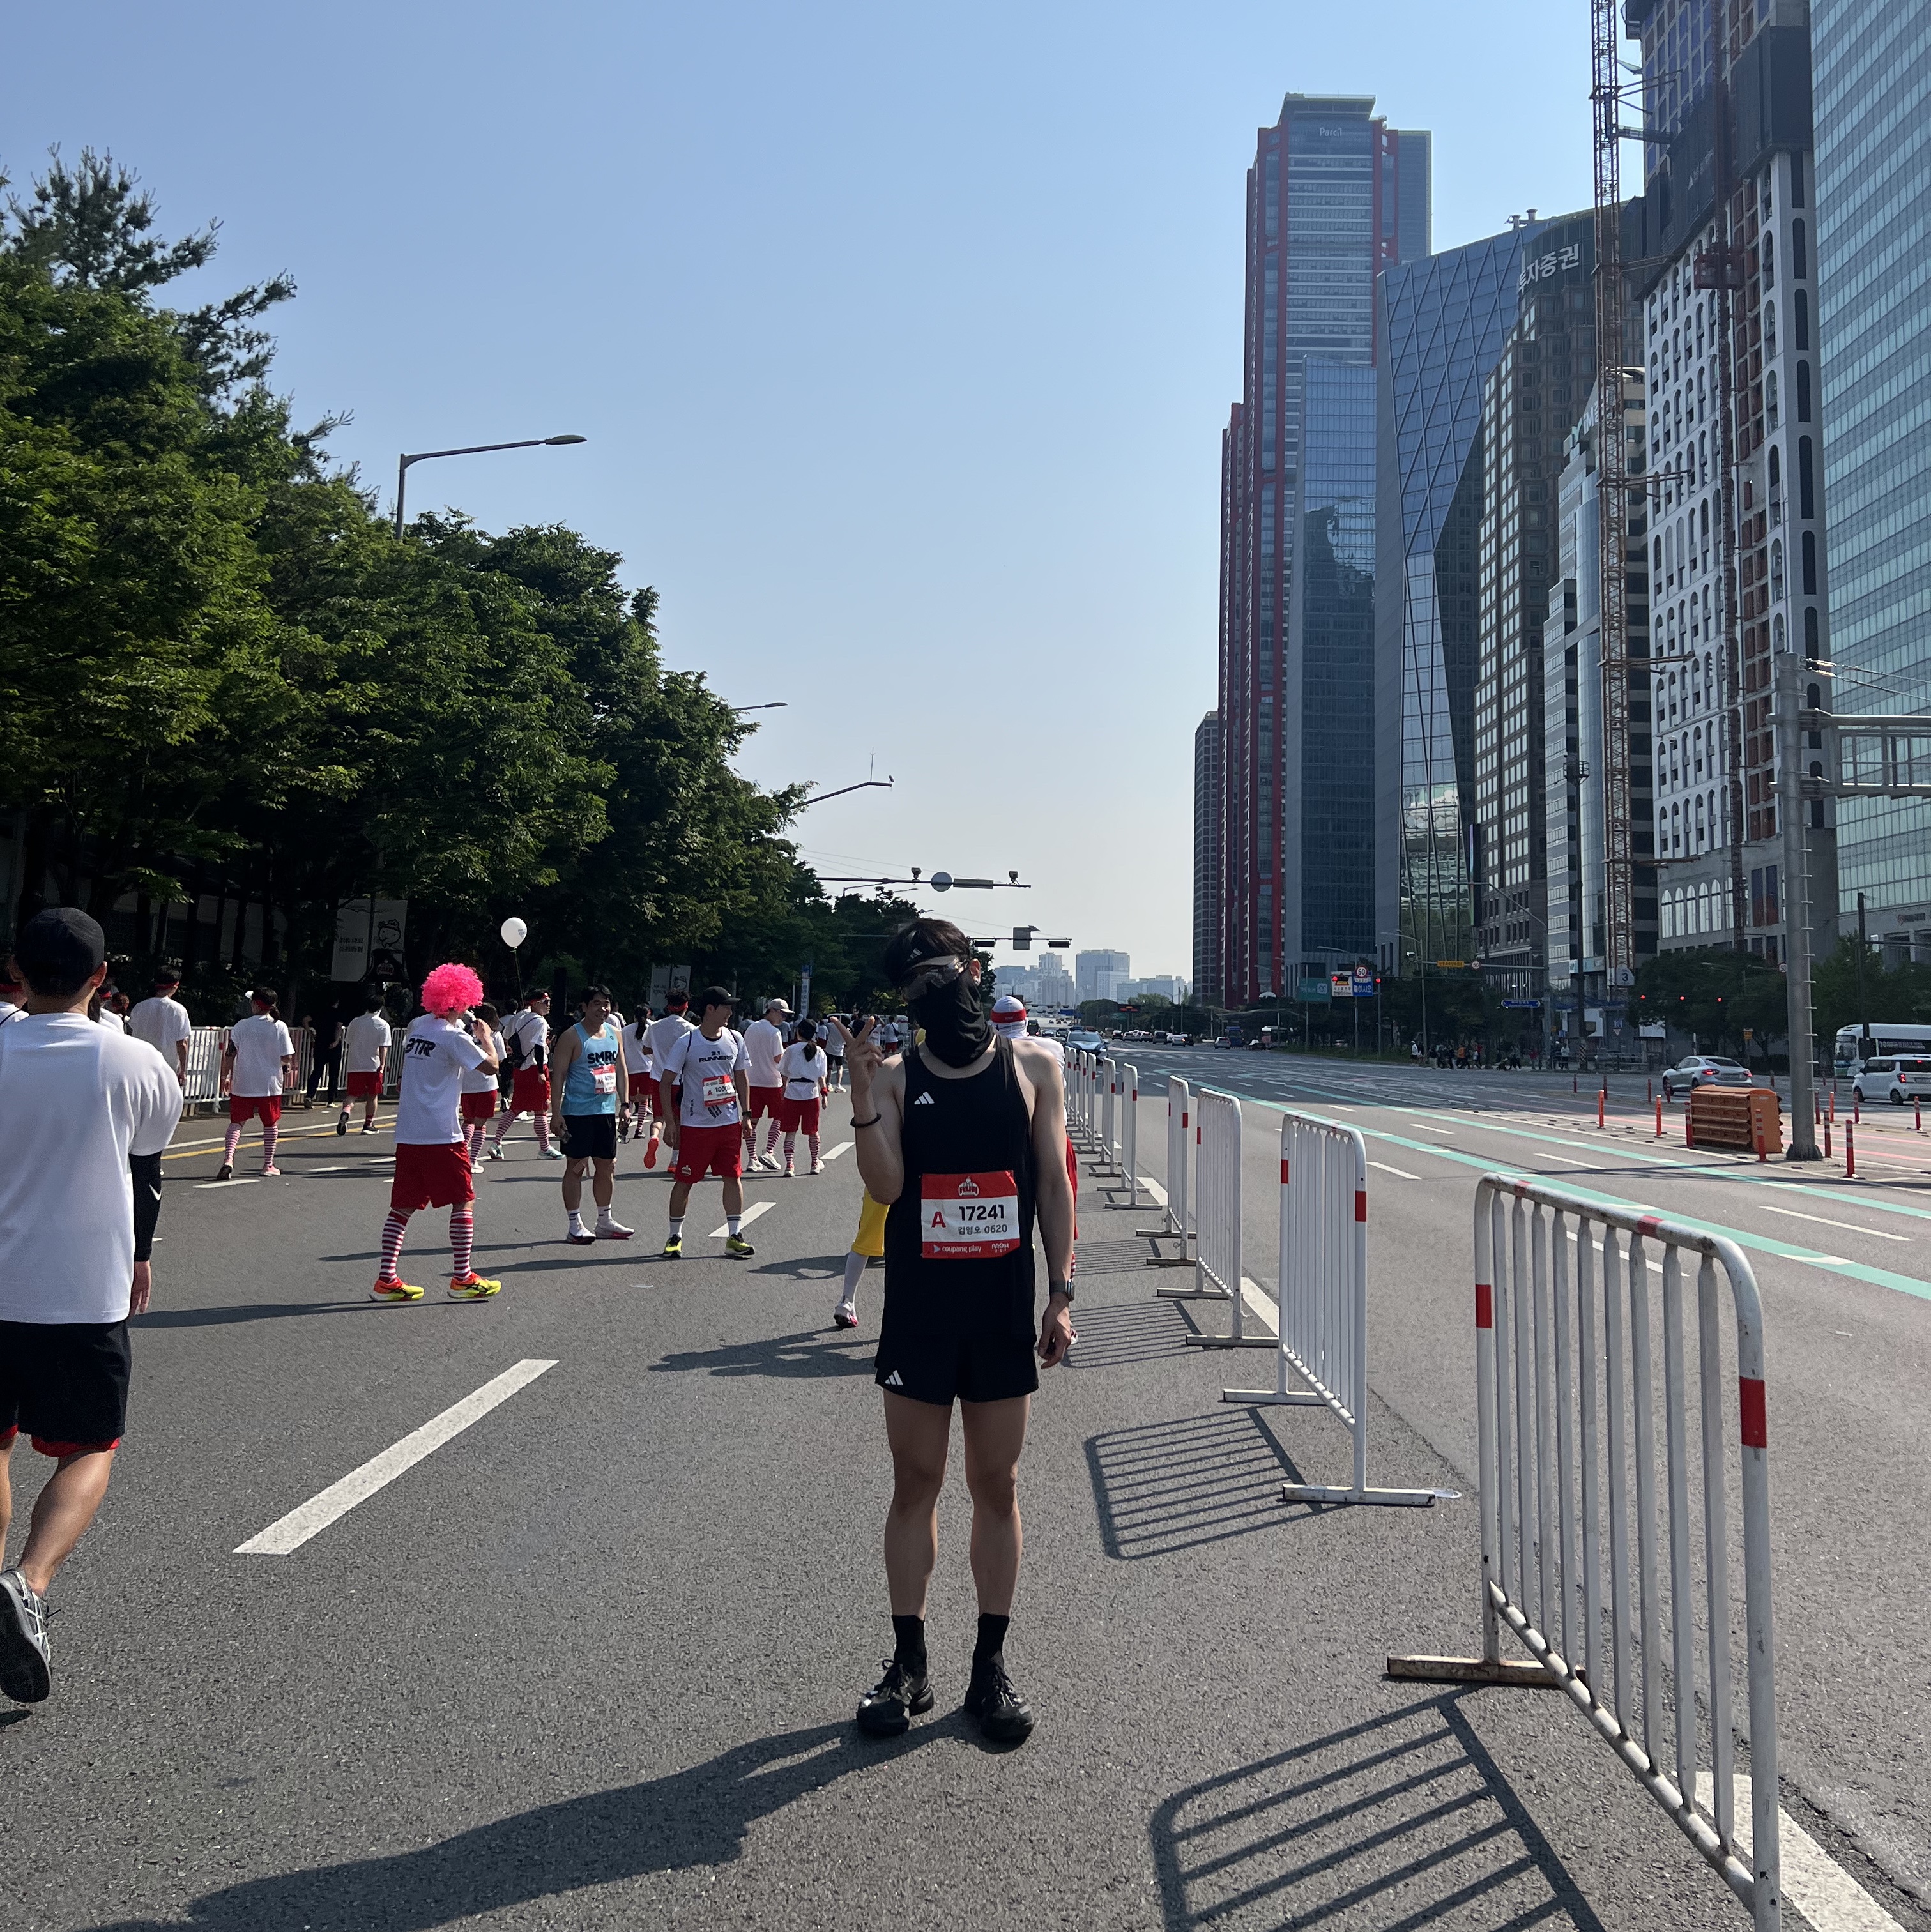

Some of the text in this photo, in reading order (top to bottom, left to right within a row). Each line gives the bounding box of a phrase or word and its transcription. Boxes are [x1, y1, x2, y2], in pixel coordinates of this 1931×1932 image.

[1518, 243, 1580, 295] 투자증권
[1622, 973, 1628, 982] 3
[959, 1204, 1004, 1221] 17241
[931, 1212, 946, 1228] A
[984, 1224, 1008, 1234] 0620
[968, 1244, 982, 1253] play
